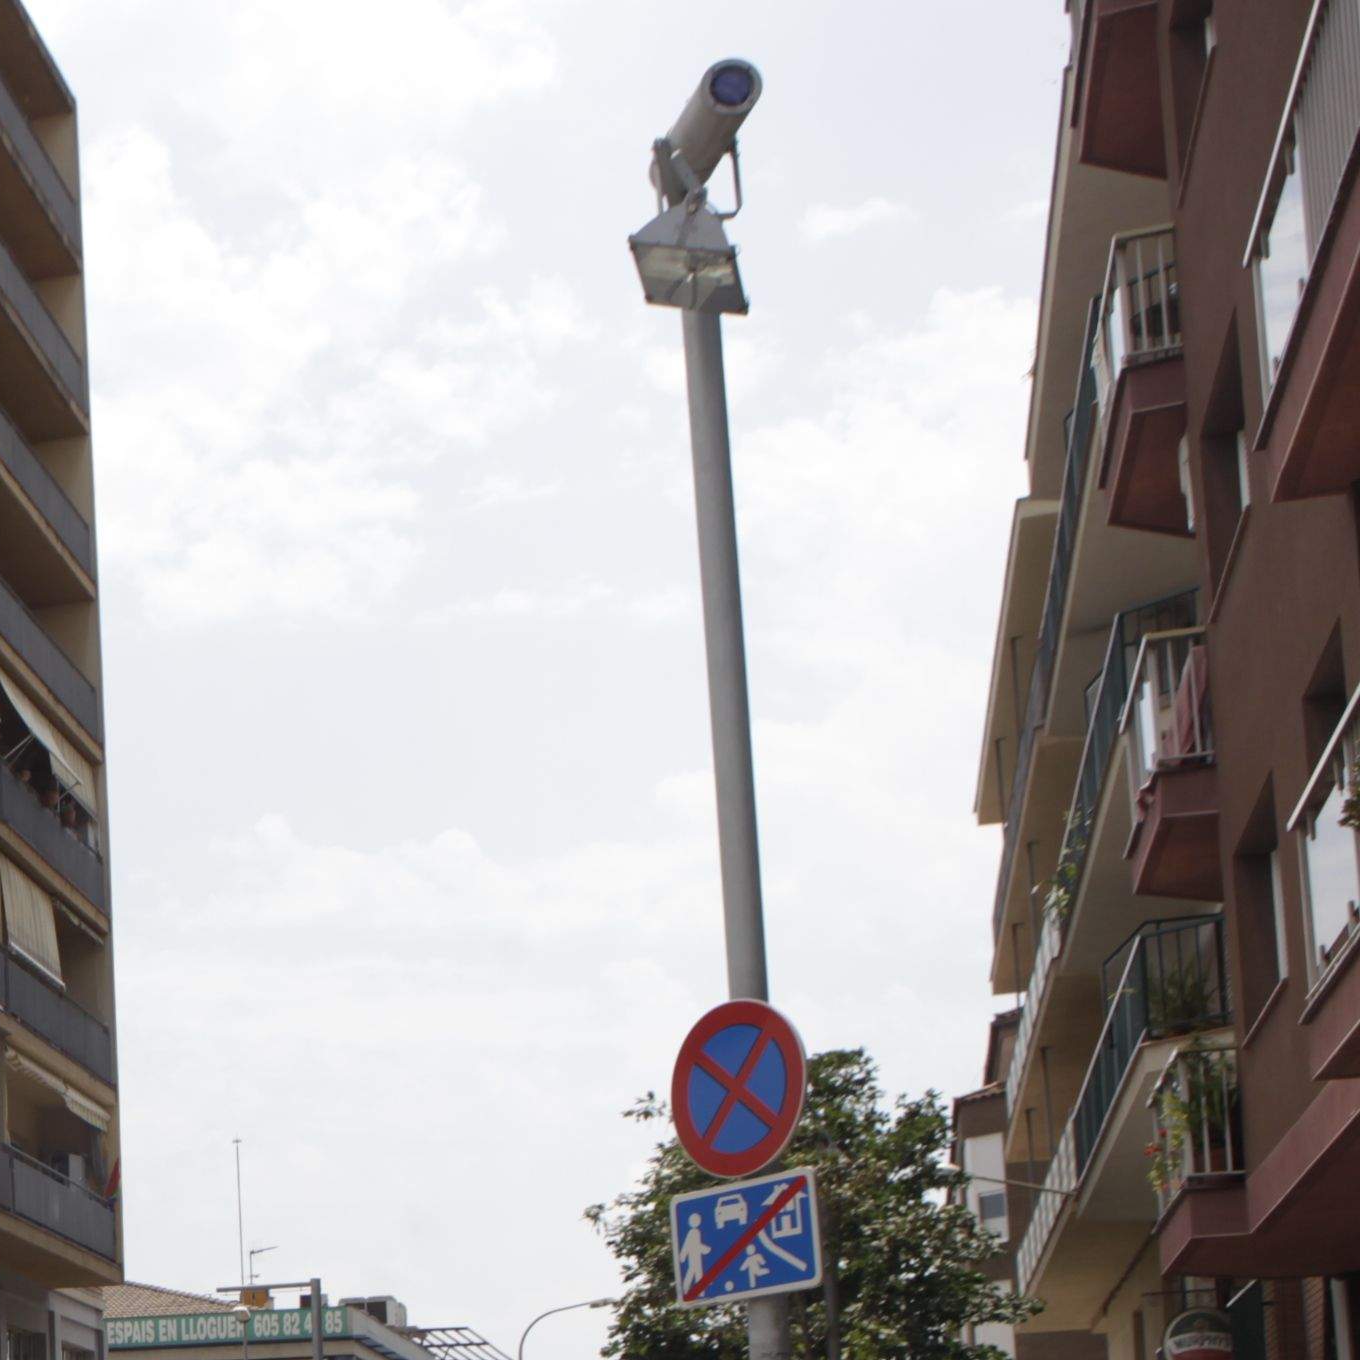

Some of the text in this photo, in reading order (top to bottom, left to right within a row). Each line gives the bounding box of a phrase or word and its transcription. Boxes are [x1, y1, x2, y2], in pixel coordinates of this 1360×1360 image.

[107, 1319, 154, 1344] ESPAIS
[159, 1319, 177, 1342] EN
[253, 1313, 280, 1338] 605
[283, 1312, 301, 1335] 82
[325, 1311, 343, 1334] 85
